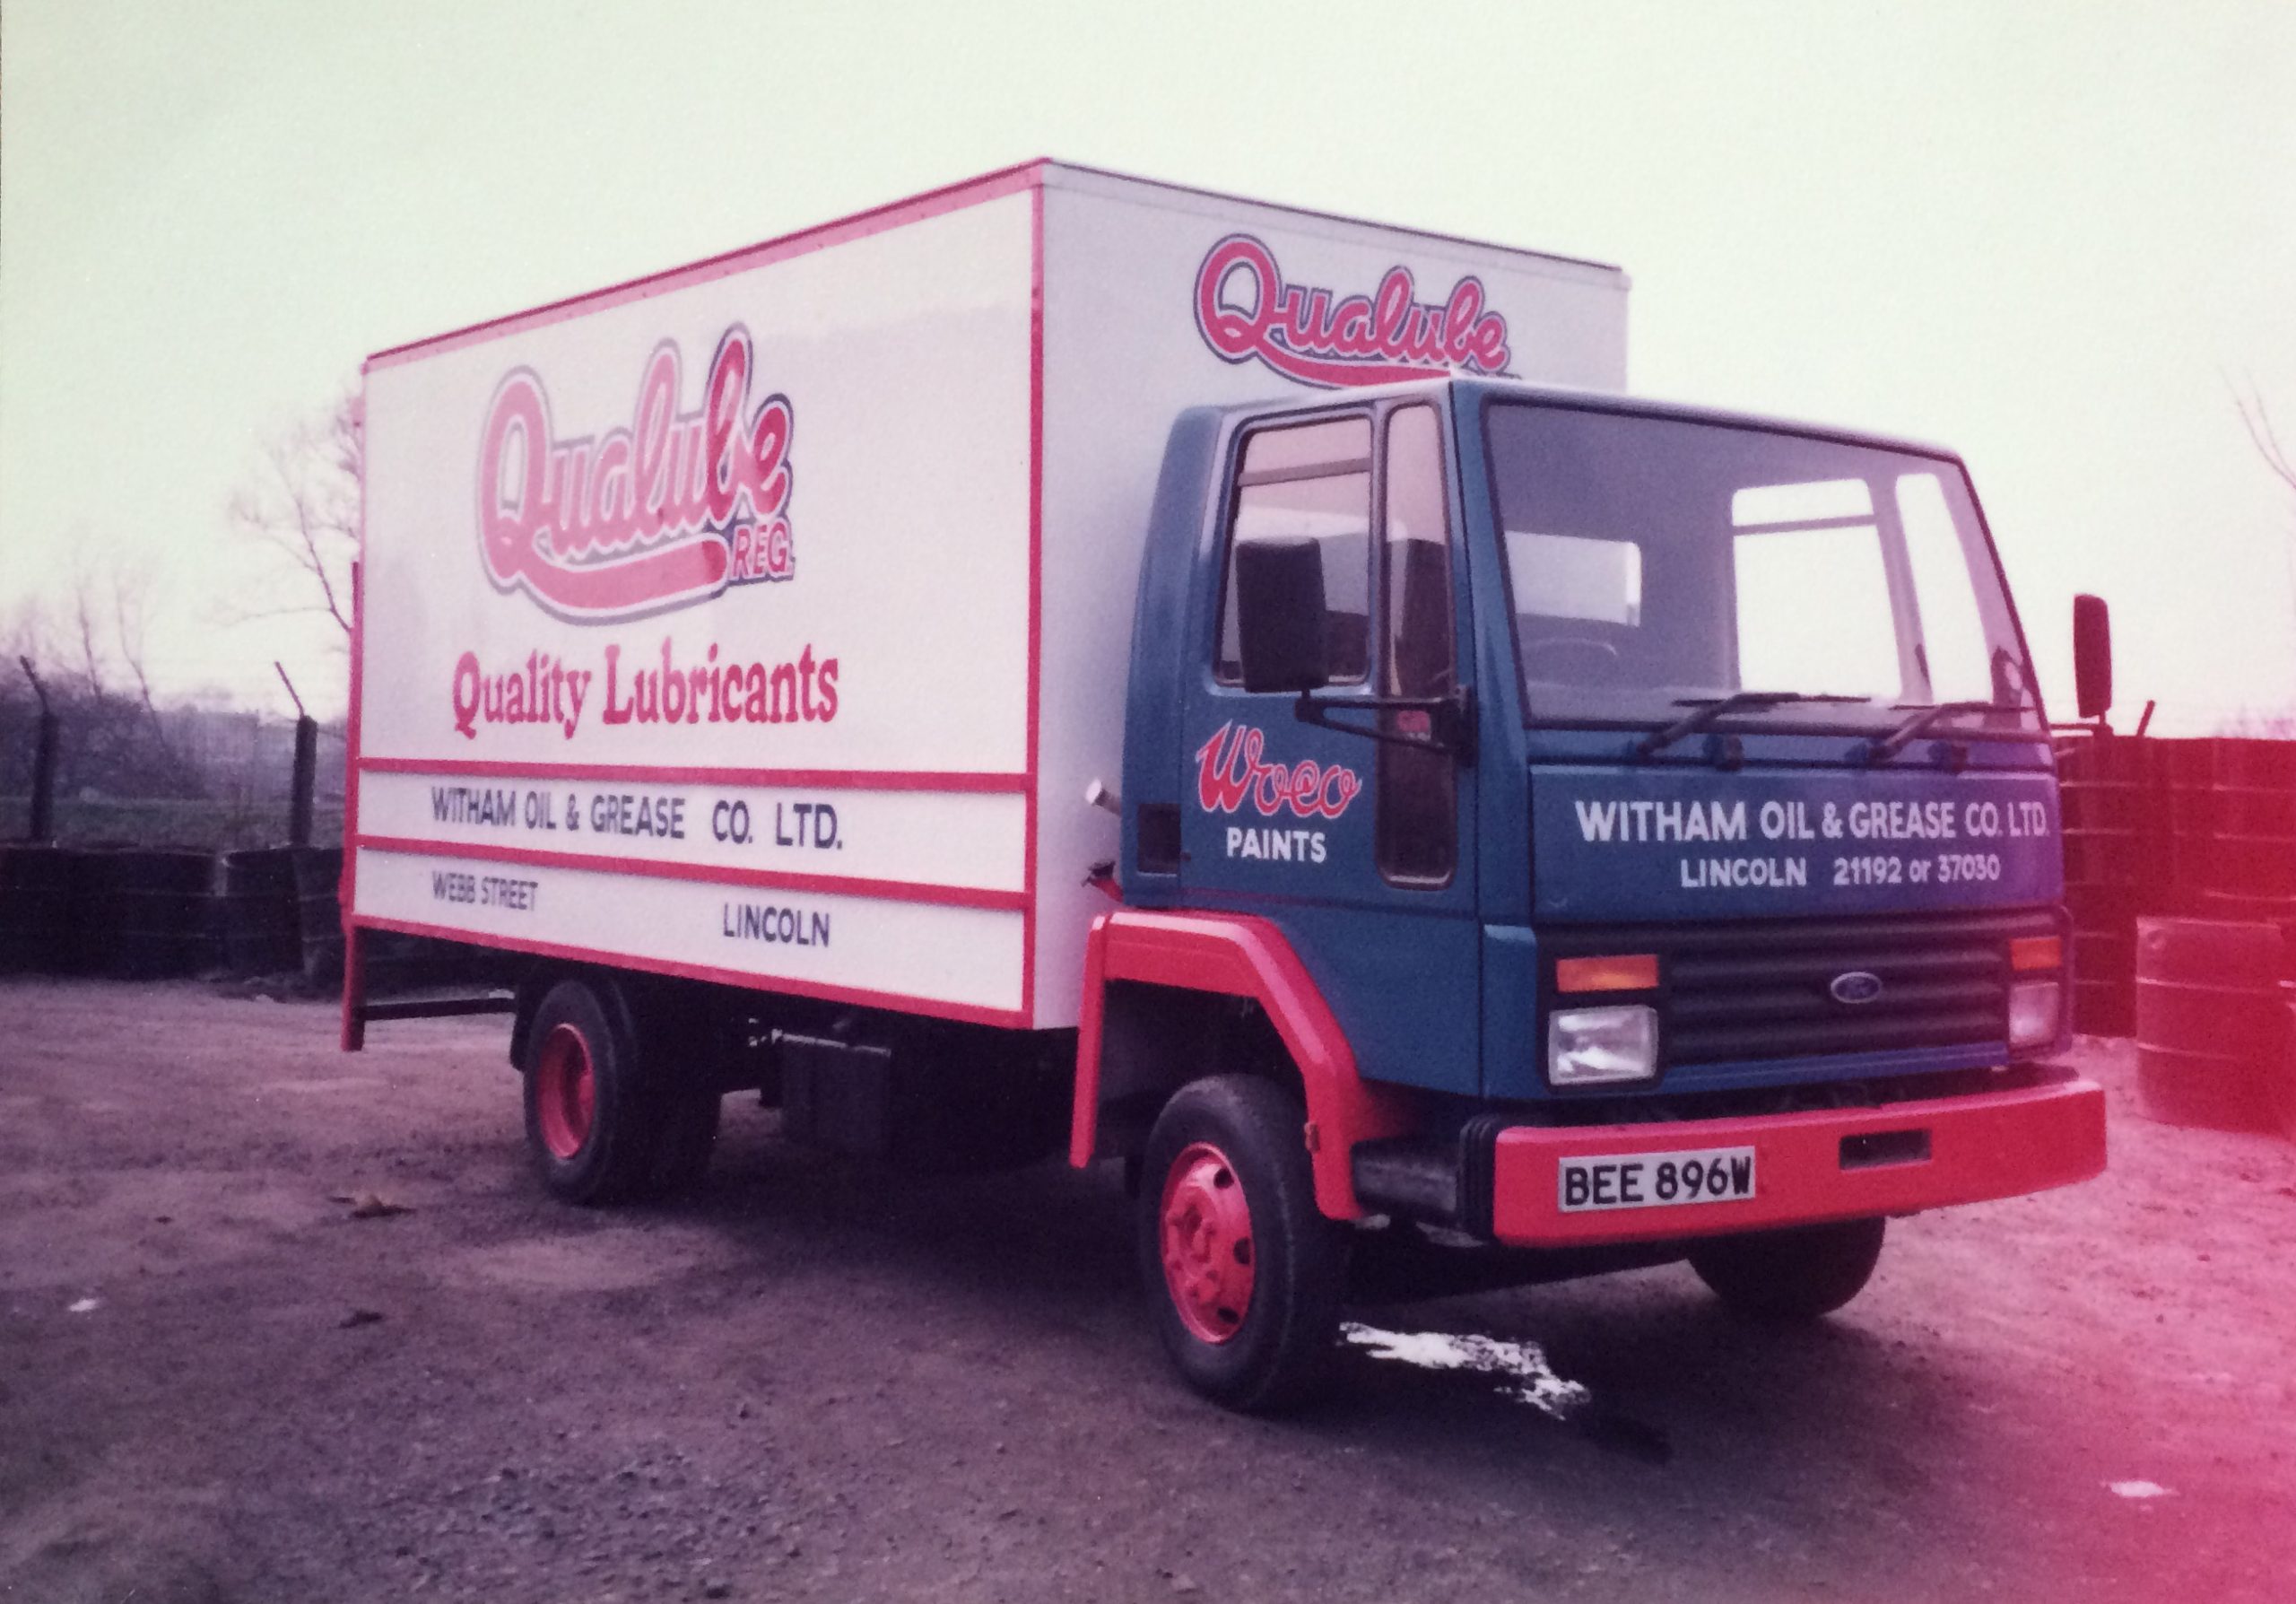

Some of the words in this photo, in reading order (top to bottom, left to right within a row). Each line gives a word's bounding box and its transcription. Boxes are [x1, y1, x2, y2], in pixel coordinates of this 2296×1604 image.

[1194, 232, 1512, 389] Qualube
[477, 321, 795, 626] Qualube
[453, 648, 591, 739] Quality
[603, 636, 839, 725] Lubricants
[431, 786, 516, 827] WITHAM
[525, 791, 556, 831] OIL
[567, 793, 579, 831] &
[590, 795, 685, 839] GREASE
[712, 799, 753, 845] CO.
[776, 802, 843, 850] LTD.
[1575, 800, 1747, 841] WITHAM
[1760, 801, 1814, 839] OIL
[1822, 802, 1842, 839] &
[1849, 801, 1955, 838] GREASE
[1226, 827, 1327, 863] PAINTS
[432, 870, 475, 904] WEBB
[482, 876, 538, 911] STREET
[1681, 857, 1807, 887] LINCOLN
[1834, 856, 1902, 885] 21192
[1909, 861, 1930, 884] or
[1938, 853, 2001, 881] 37030
[723, 903, 831, 947] LINCOLN
[1565, 1163, 1644, 1207] BEE
[1656, 1155, 1751, 1200] 896W
